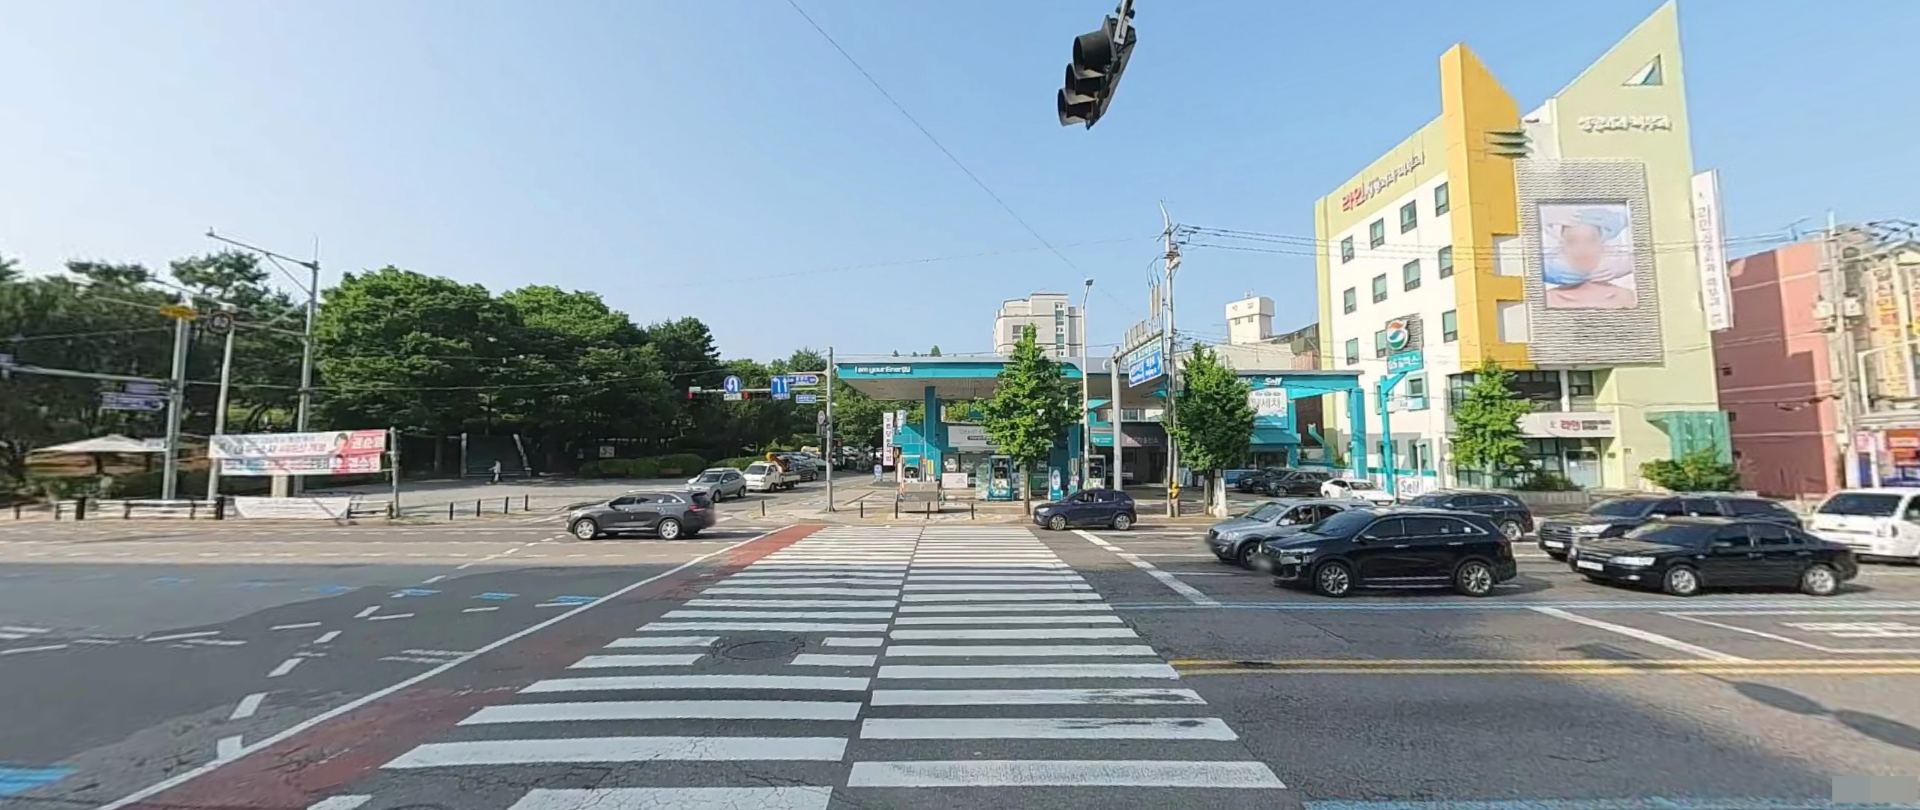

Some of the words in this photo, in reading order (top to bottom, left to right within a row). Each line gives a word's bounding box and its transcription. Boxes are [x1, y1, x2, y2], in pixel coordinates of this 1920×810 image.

[1342, 186, 1366, 212] 라인
[869, 367, 886, 375] your
[886, 365, 911, 374] Energy
